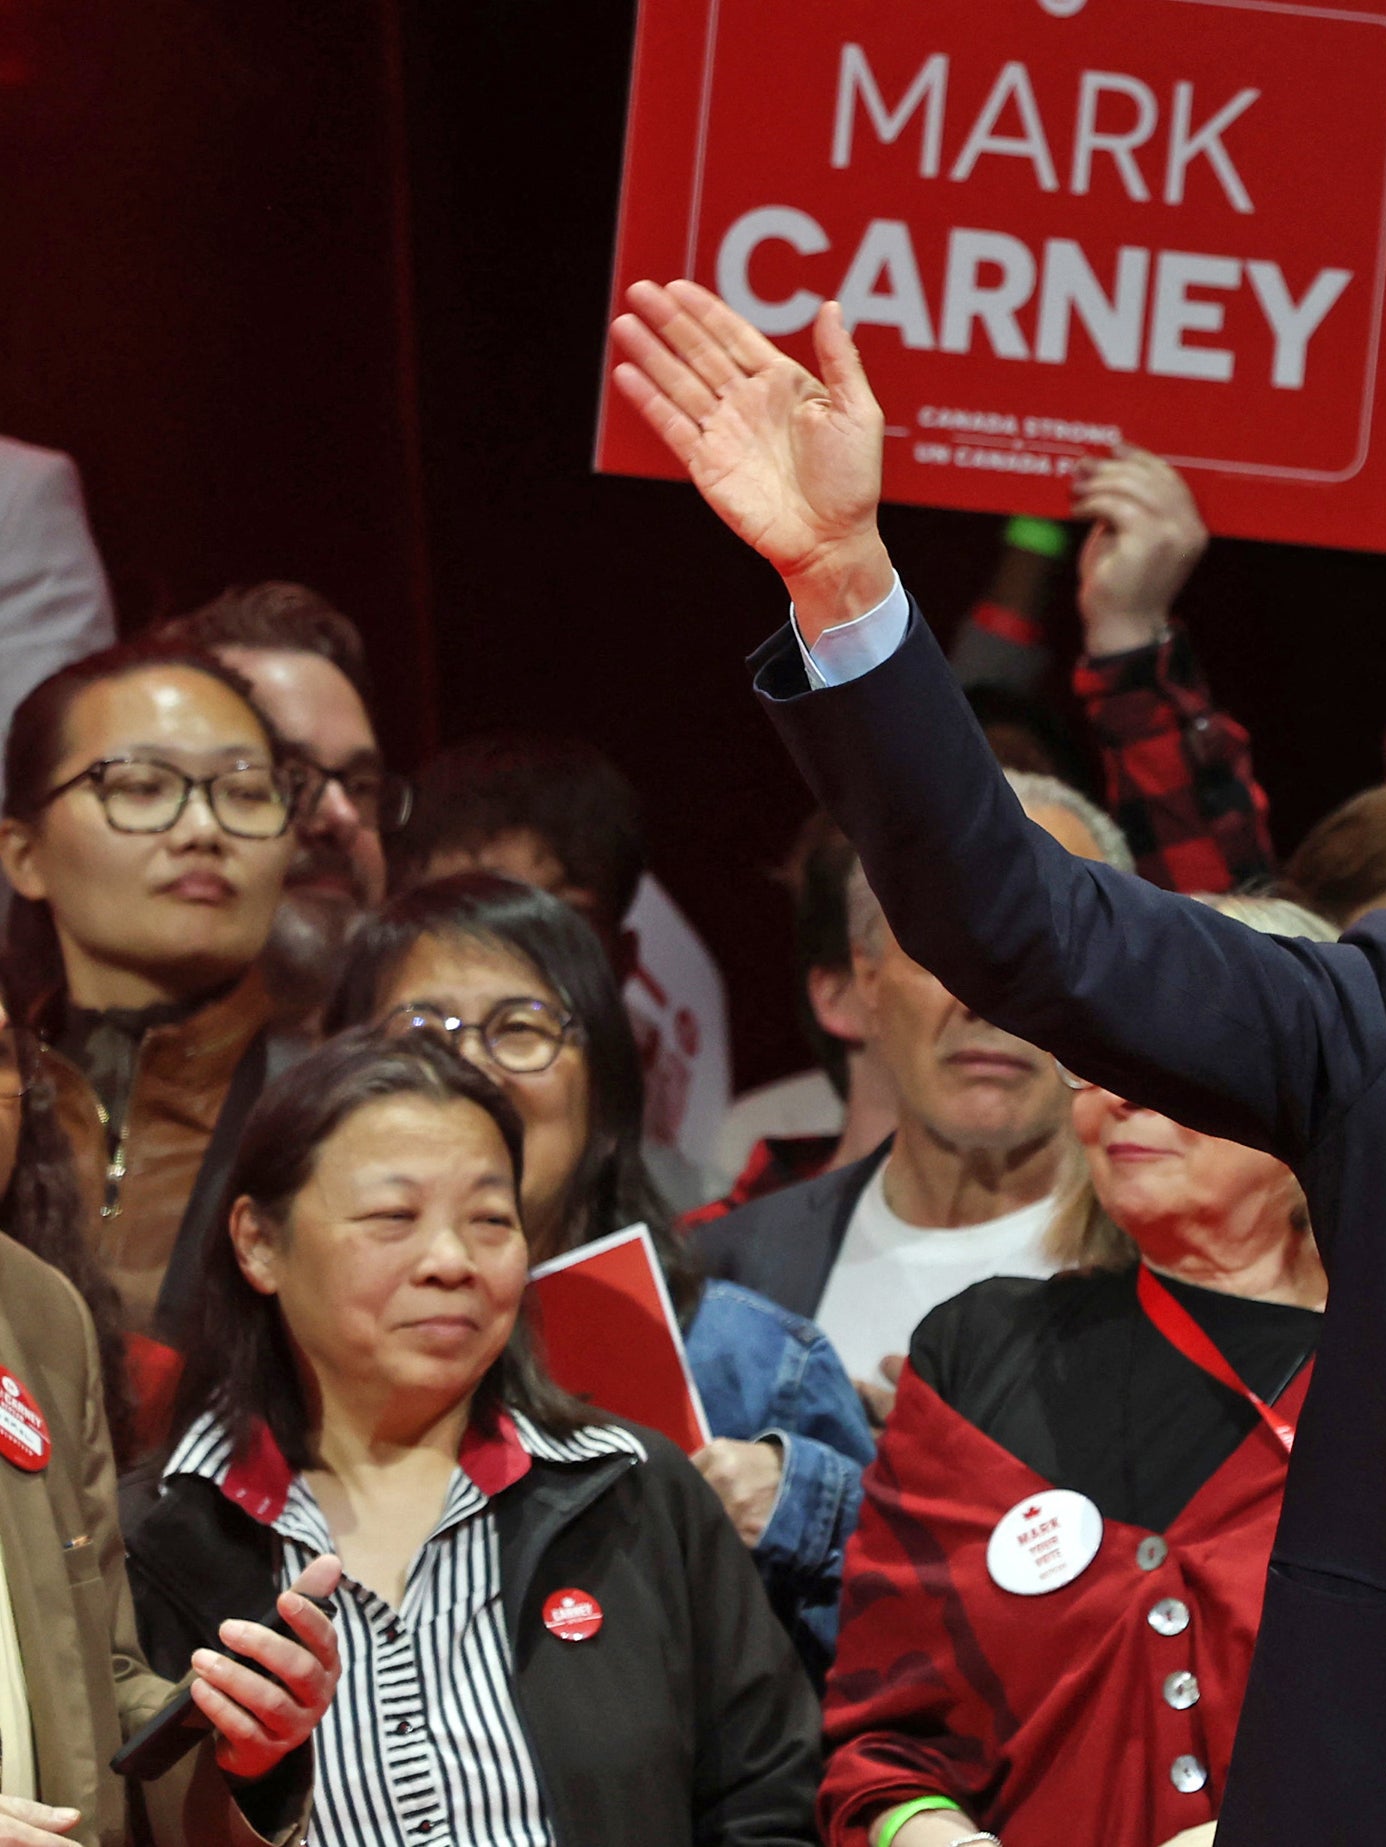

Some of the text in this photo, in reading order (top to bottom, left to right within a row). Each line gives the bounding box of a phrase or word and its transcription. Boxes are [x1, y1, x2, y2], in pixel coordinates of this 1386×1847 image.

[830, 42, 1261, 213] MARK
[716, 204, 1354, 389] CARNEY
[913, 441, 951, 465] UN
[953, 448, 1051, 475] CANADA
[917, 404, 1121, 446] CANADA STRONG
